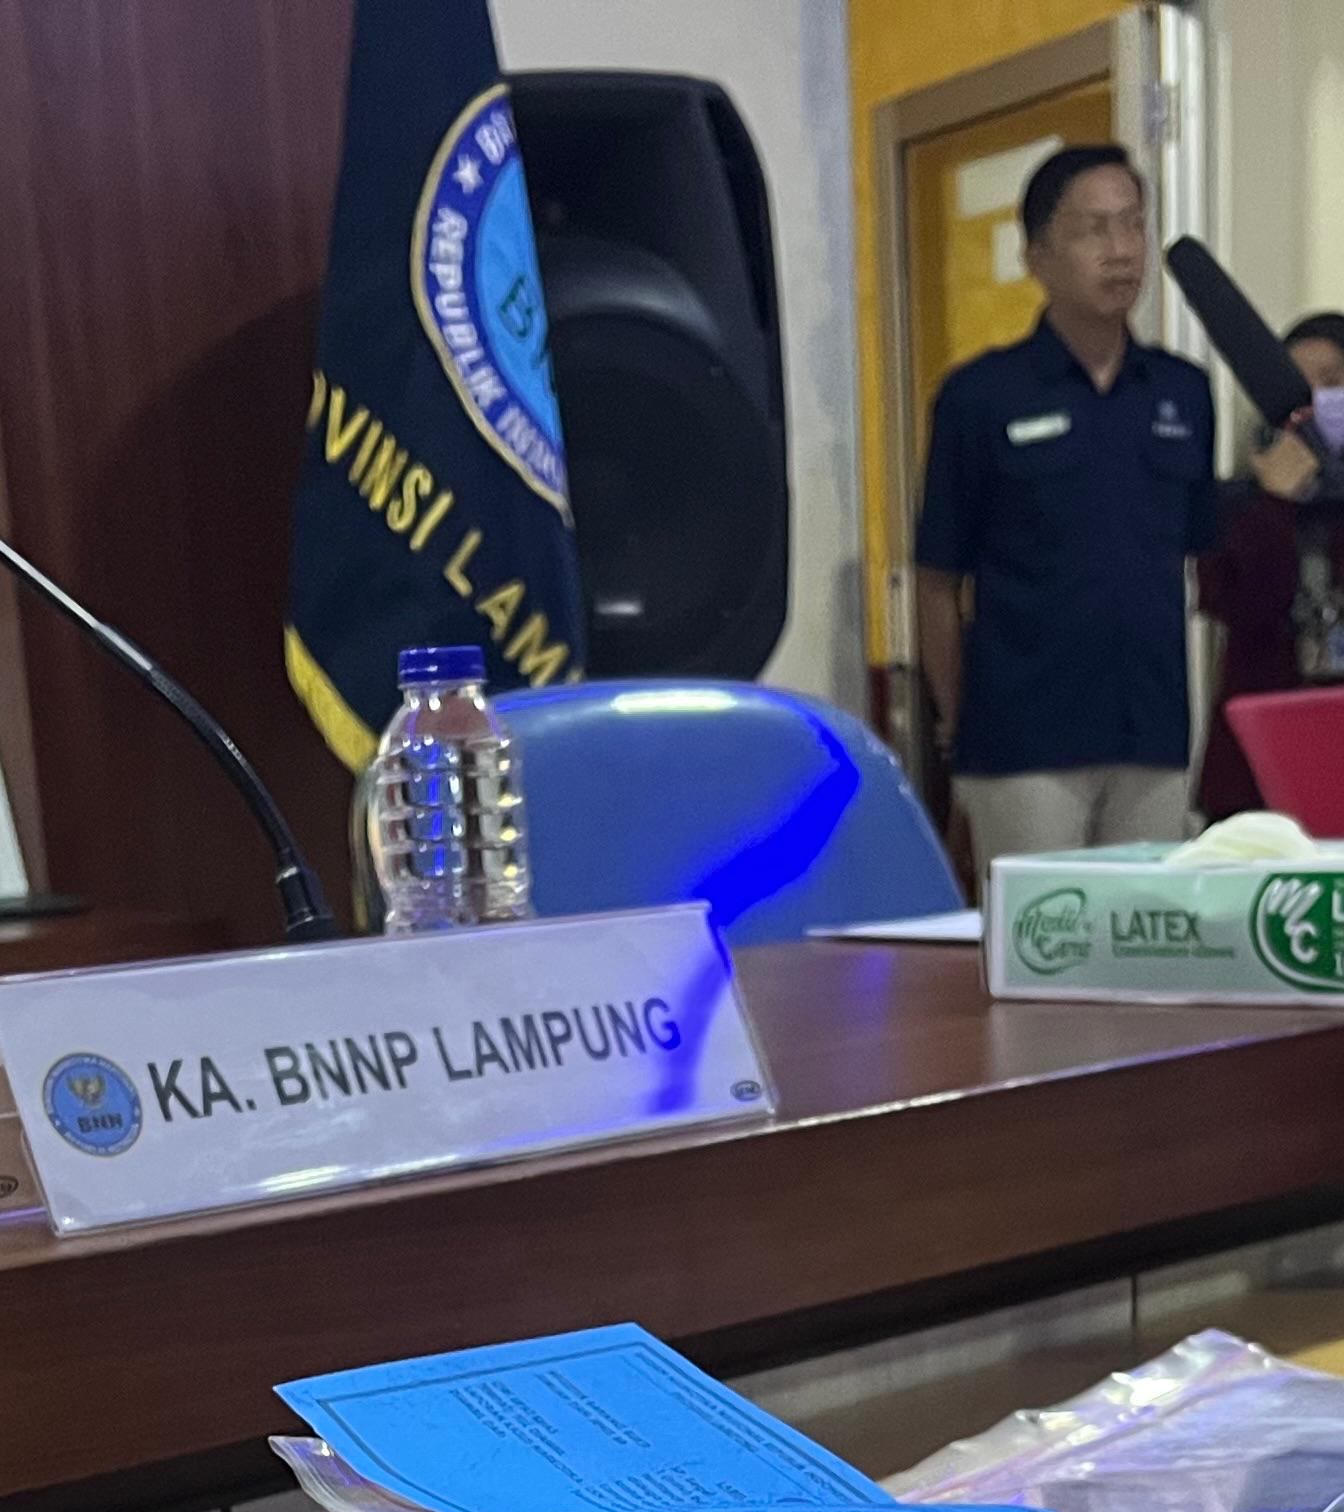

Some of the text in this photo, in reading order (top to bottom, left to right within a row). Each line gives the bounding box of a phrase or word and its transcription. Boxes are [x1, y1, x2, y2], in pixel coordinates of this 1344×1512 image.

[444, 528, 584, 688] LAM
[1110, 908, 1203, 943] LATEX
[146, 996, 682, 1122] KA. BNNP LAMPUNG
